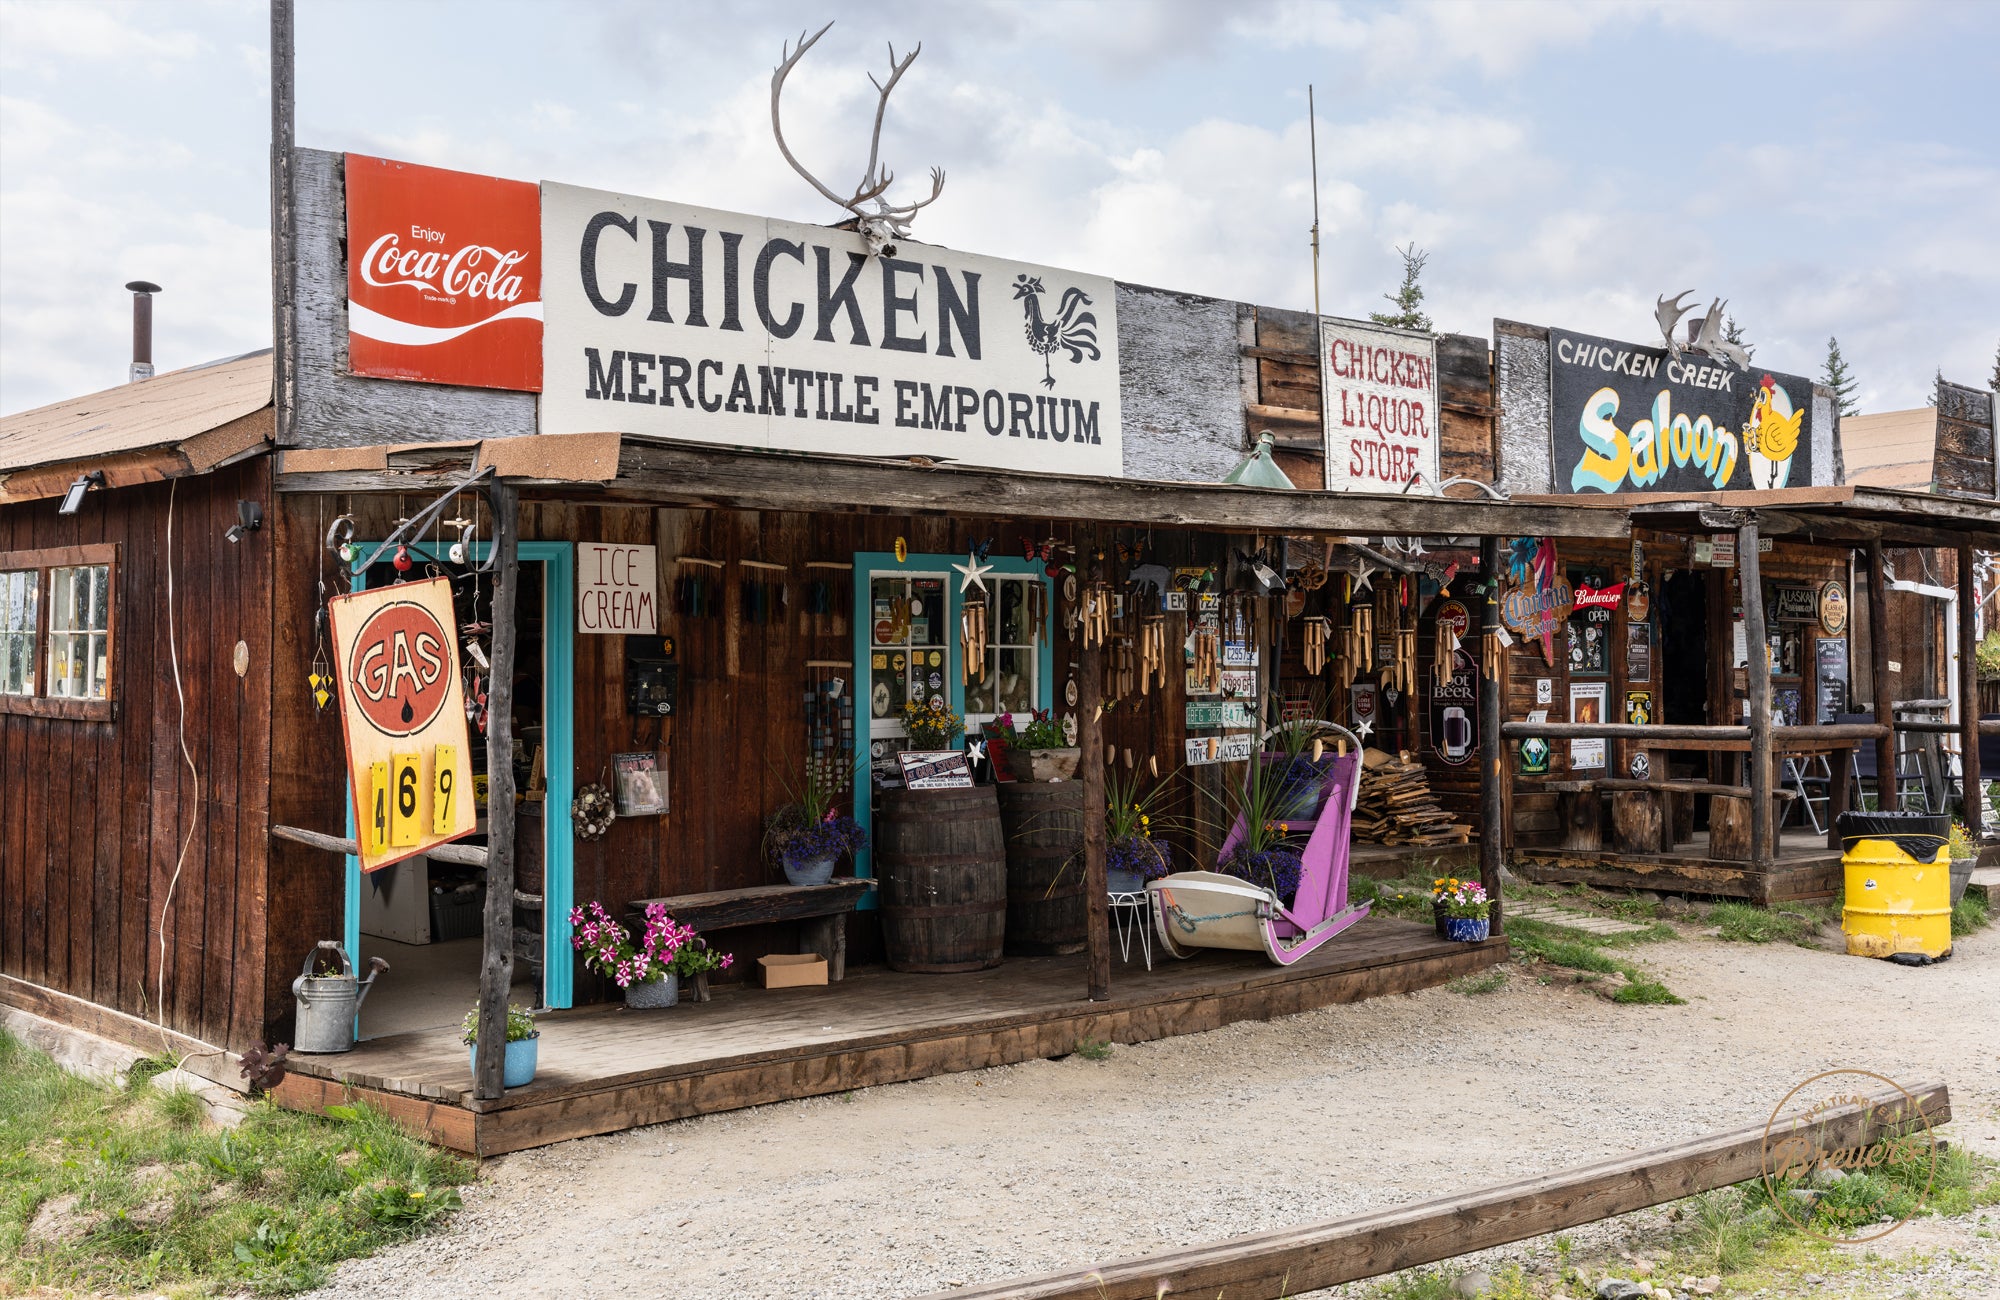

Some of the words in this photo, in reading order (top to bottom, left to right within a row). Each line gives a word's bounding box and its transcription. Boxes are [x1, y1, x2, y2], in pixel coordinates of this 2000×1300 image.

[411, 225, 446, 243] Enjoy
[361, 233, 529, 302] Coca-Cola
[580, 211, 981, 360] CHICKEN
[1331, 339, 1431, 391] CHICKEN
[1557, 338, 1661, 378] CHICKEN
[1667, 361, 1734, 393] CREEK
[584, 347, 879, 425] MERCANTILE
[894, 379, 1102, 445] EMPORIUM
[1341, 389, 1429, 440] LIQUOR
[1571, 387, 1738, 494] Saloon
[1349, 438, 1420, 486] STORE
[593, 546, 640, 587] ICE
[581, 590, 656, 630] CREAM
[1504, 584, 1570, 627] Corona
[1574, 588, 1621, 605] Budweiser
[1588, 610, 1610, 622] OPEN
[1776, 590, 1818, 617] ALASKAN
[1524, 617, 1558, 639] Extra
[356, 629, 445, 702] GAS
[1224, 678, 1241, 691] 7989
[1435, 674, 1470, 687] oot
[1208, 708, 1221, 722] 382
[915, 763, 936, 779] OUR
[935, 756, 966, 774] STORE
[375, 787, 385, 845] 4
[398, 766, 417, 818] 6
[439, 768, 453, 821] 9
